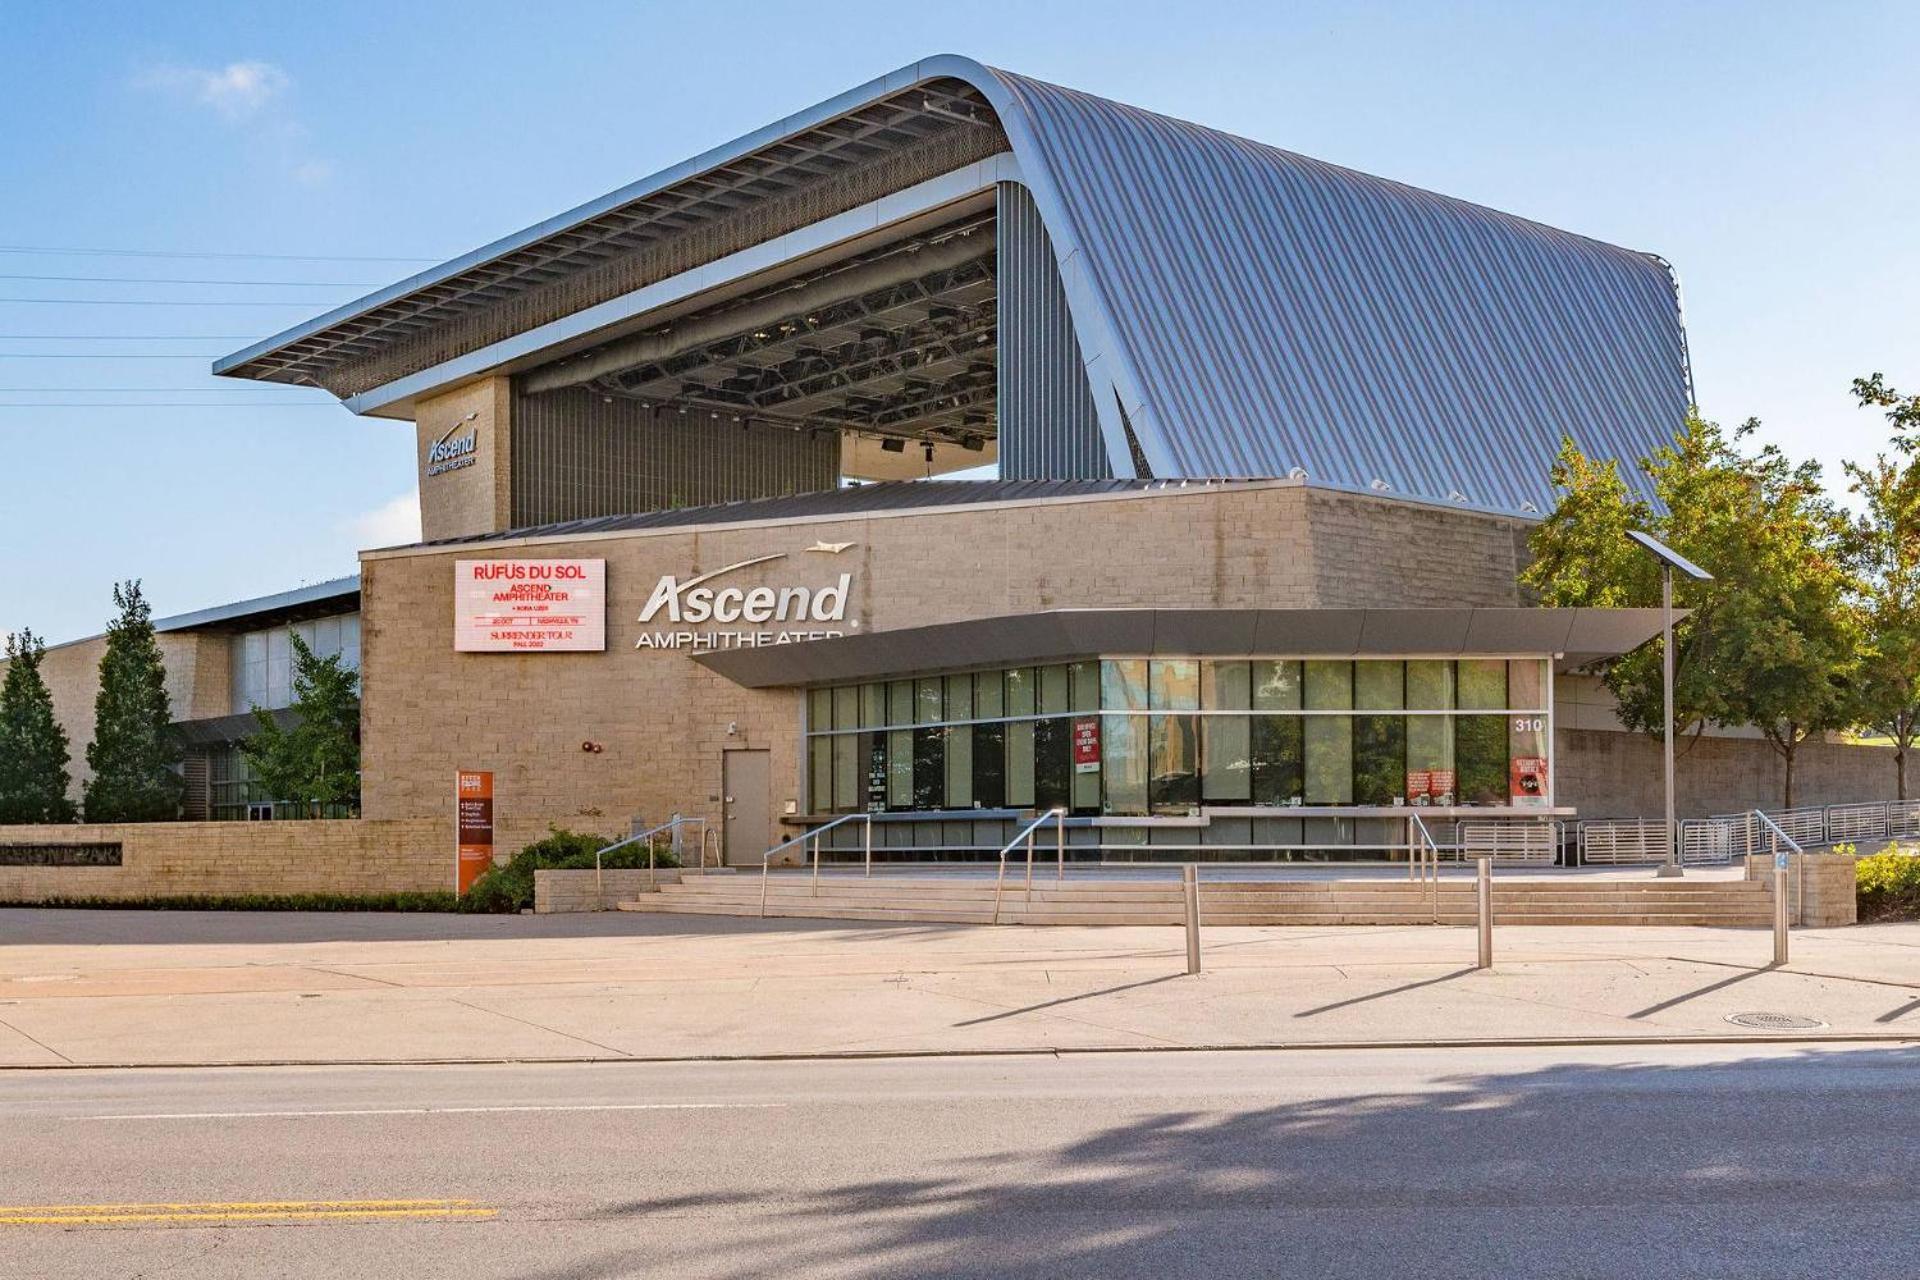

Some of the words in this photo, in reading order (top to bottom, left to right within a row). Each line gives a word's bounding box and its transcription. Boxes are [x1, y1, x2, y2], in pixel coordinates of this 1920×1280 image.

[428, 427, 477, 463] Ascend
[474, 564, 526, 580] RÜFÜS
[529, 566, 552, 579] DU
[555, 565, 587, 579] SOL
[510, 584, 552, 593] ASCEND
[492, 592, 569, 602] AMPHITHEATER
[637, 573, 852, 623] Ascend
[490, 631, 545, 640] SURRENDER
[547, 631, 573, 640] TOUR
[1515, 718, 1543, 732] 310
